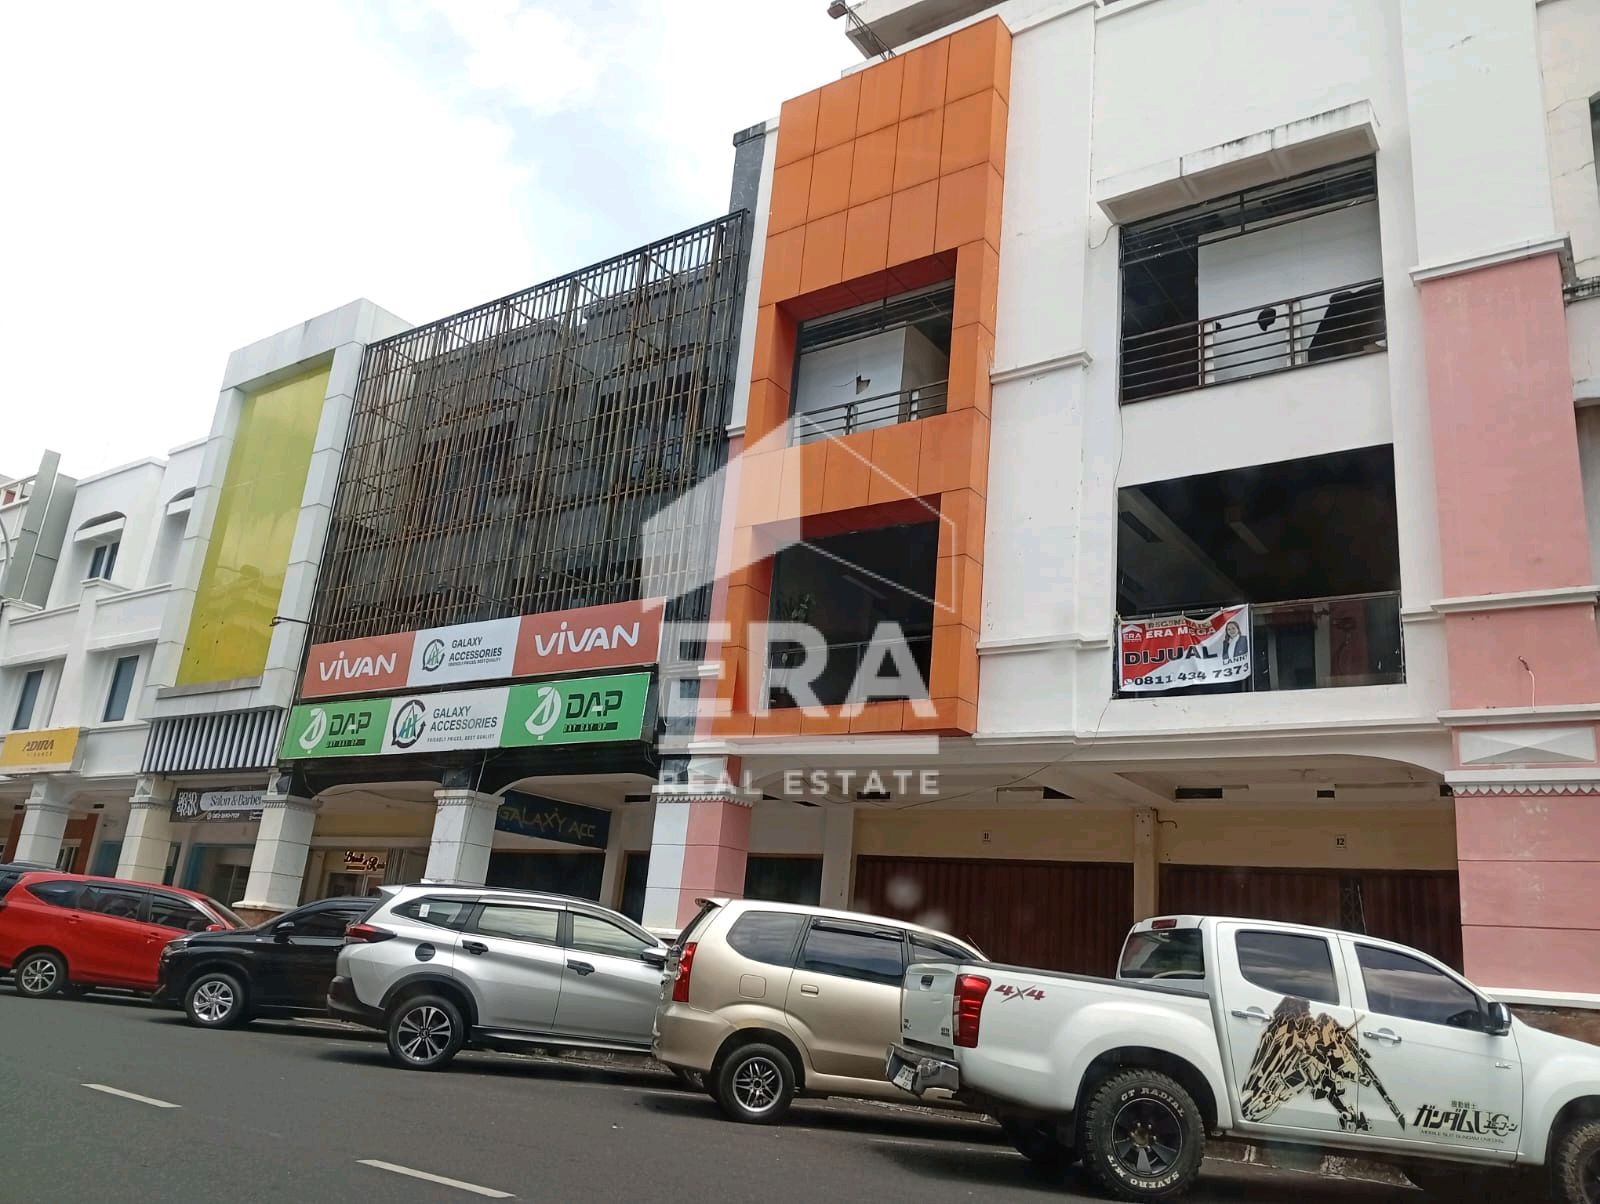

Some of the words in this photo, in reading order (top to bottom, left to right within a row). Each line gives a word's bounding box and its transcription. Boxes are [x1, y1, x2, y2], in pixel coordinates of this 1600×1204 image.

[1145, 629, 1174, 639] ERA
[452, 637, 483, 649] GALAXY
[449, 647, 503, 662] ACCESSORIES
[1124, 645, 1218, 666] DIJUAL
[1222, 654, 1248, 665] LANN
[1134, 674, 1174, 686] 0811
[1178, 671, 1207, 681] 434
[1212, 662, 1249, 679] 7373
[433, 705, 472, 719] GALAXY
[565, 690, 623, 719] DAP
[328, 711, 372, 736] DAP
[430, 716, 498, 732] ACCESSORIES
[22, 739, 55, 751] ADIRA
[210, 795, 231, 807] Salon
[231, 797, 237, 806] &
[498, 806, 567, 833] GALAXY
[568, 821, 597, 840] ACC
[1336, 838, 1345, 846] 12
[1121, 1089, 1136, 1101] GT
[1140, 1087, 1185, 1118] RADIAL
[1130, 1171, 1180, 1188] SAVERO
